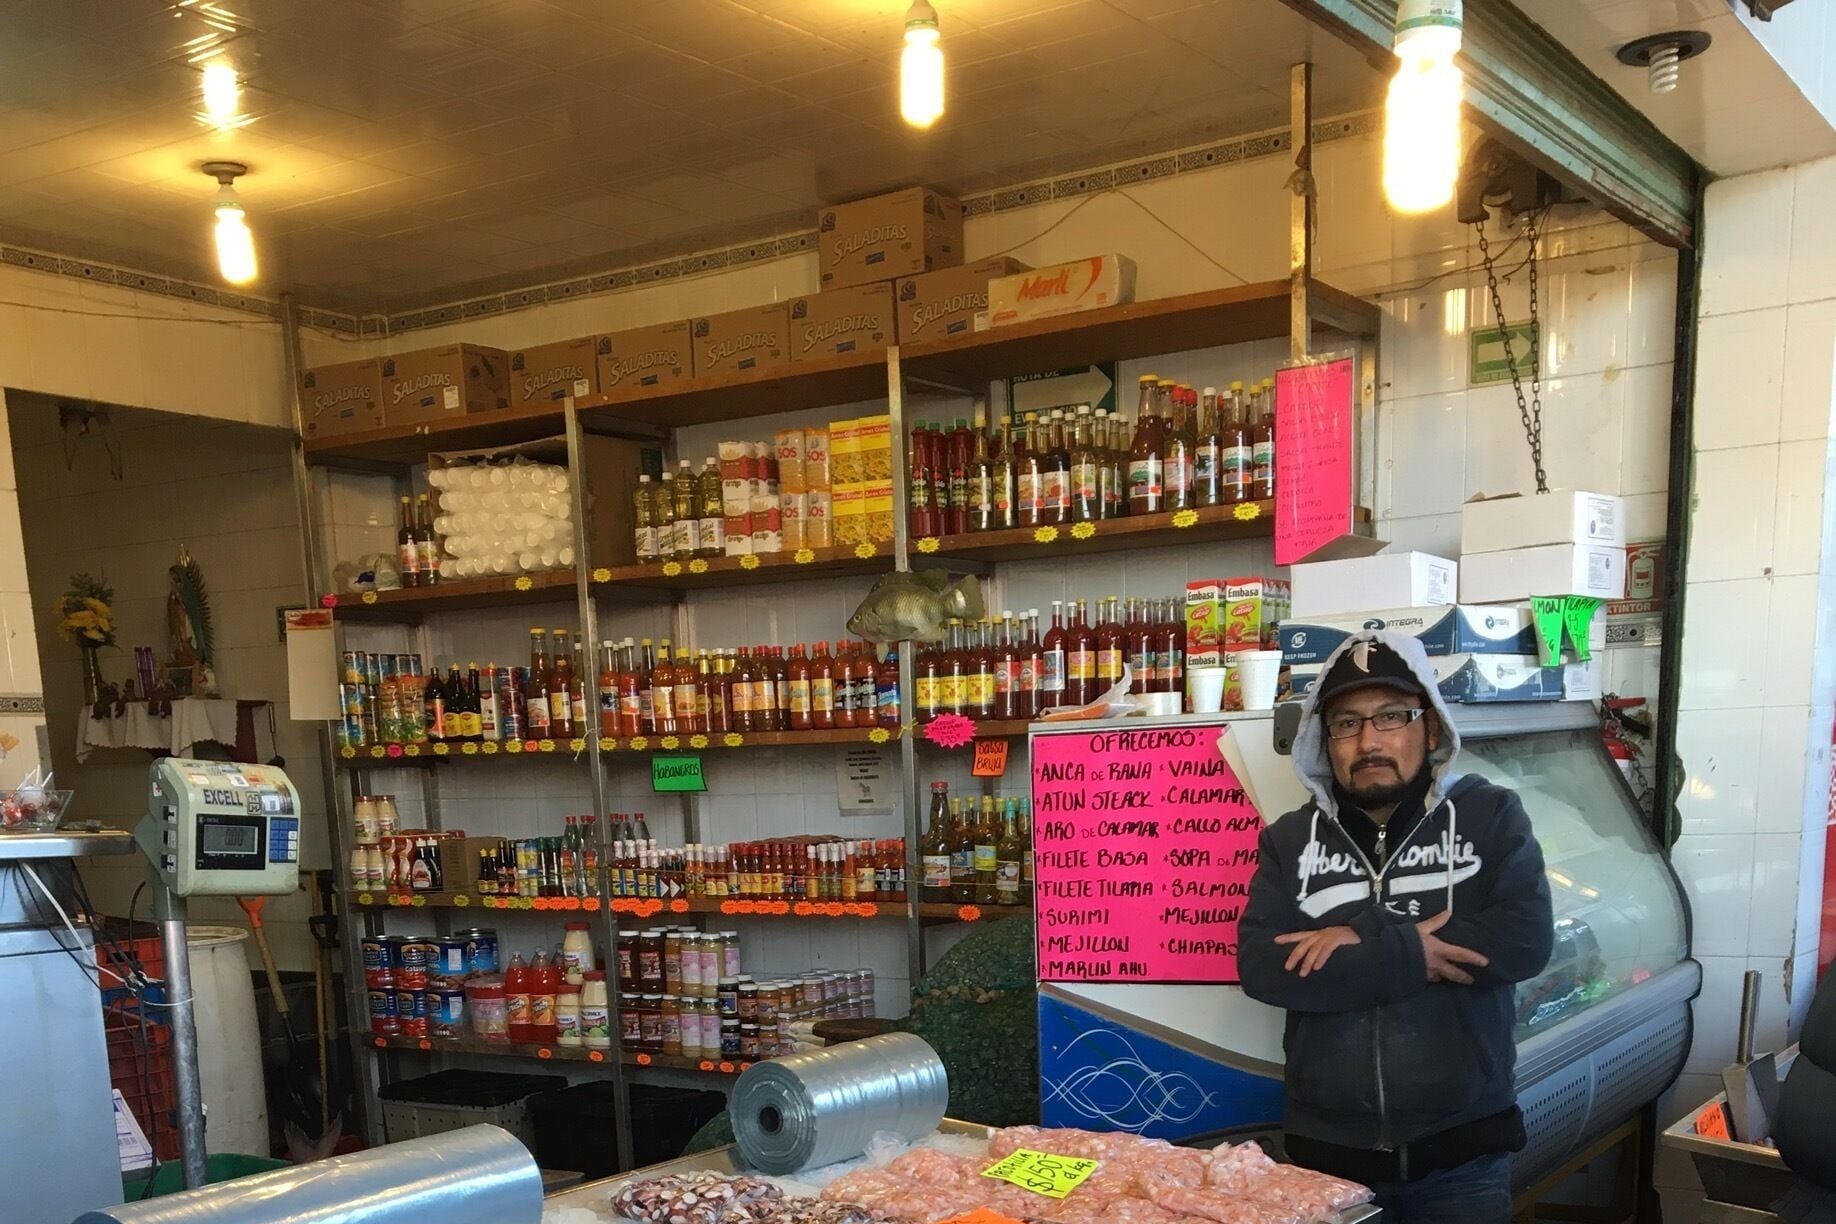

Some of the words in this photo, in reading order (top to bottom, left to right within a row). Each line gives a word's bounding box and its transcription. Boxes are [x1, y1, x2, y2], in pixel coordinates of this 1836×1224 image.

[831, 224, 907, 267] SALADITAS
[803, 314, 880, 352] SALADITAS
[706, 332, 776, 368] SALADITAS
[610, 351, 678, 386] SALADITAS
[393, 373, 451, 404] SALADITAS
[523, 366, 584, 400] SALADITAS
[314, 386, 371, 417] SALADITAS
[1187, 591, 1215, 602] Embasa
[1228, 587, 1259, 598] Embasa
[1187, 656, 1216, 666] Embasa
[1090, 731, 1205, 753] OFRECEMOS:
[1040, 762, 1086, 782] ANCA
[1091, 771, 1105, 781] DE
[1108, 762, 1152, 780] RANA
[1168, 758, 1225, 778] VAINA
[203, 788, 244, 807] EXCELL
[1041, 789, 1086, 812] ATUN
[1092, 790, 1154, 811] STEACK
[1043, 821, 1076, 841] ARO
[1081, 829, 1096, 838] DE
[1097, 820, 1159, 839] CALAMAR
[1173, 818, 1221, 835] CALLO
[1042, 850, 1090, 869] FILETE
[1170, 850, 1211, 868] SOPA
[1042, 879, 1093, 899] FILETE
[1099, 880, 1153, 898] TILAPIA
[1047, 908, 1110, 926] SURIMI
[1164, 906, 1240, 925] MEJILLON
[1048, 935, 1130, 954] MEJILLON
[1049, 960, 1112, 979] MARLIN
